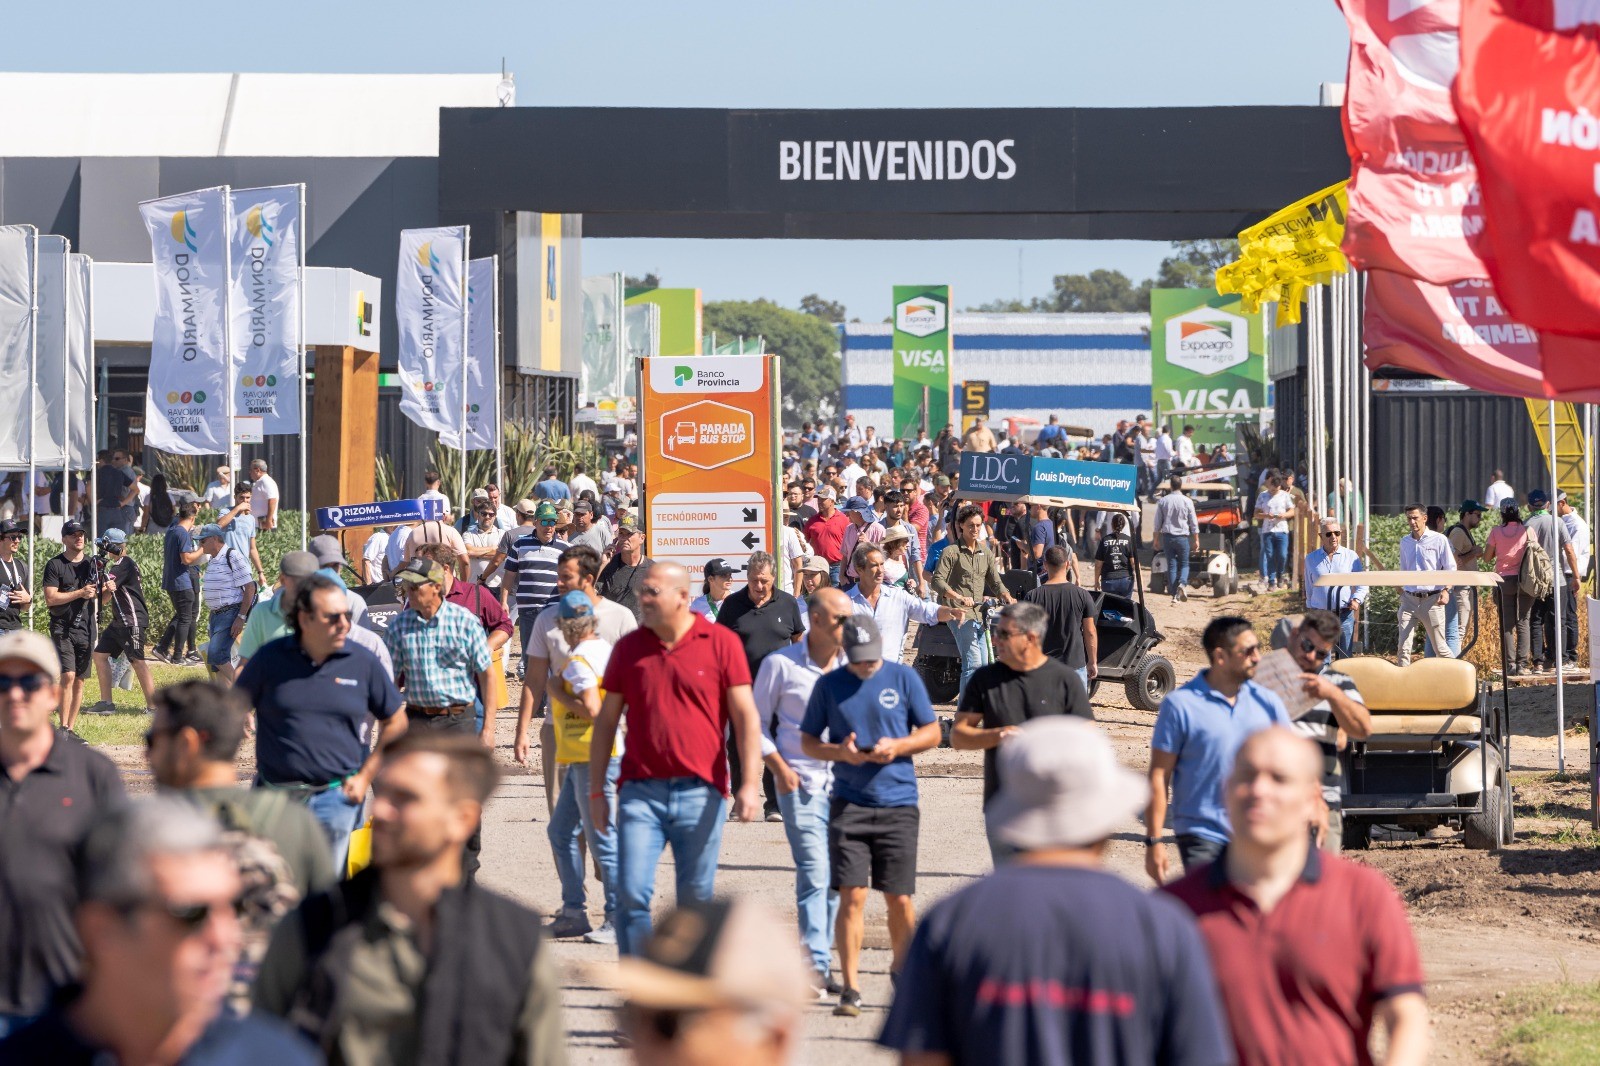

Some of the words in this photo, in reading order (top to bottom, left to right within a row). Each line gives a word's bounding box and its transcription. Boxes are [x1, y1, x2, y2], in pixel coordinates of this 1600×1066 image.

[779, 139, 1017, 180] BIENVENIDOS
[1180, 340, 1233, 353] Expoagro
[897, 349, 945, 367] VISA
[697, 370, 725, 378] Banco
[697, 378, 740, 387] Provincia
[966, 385, 985, 409] 5
[1163, 388, 1254, 418] VISA
[700, 423, 746, 435] PARADA
[700, 435, 719, 444] BUS
[721, 434, 746, 444] STOP
[1035, 470, 1057, 482] Louis
[1059, 472, 1091, 487] Dreyfus
[1092, 475, 1131, 491] Company
[344, 505, 382, 517] RIZOMA
[656, 511, 717, 522] TECNÓDROMO
[657, 537, 710, 546] SANITARIOS
